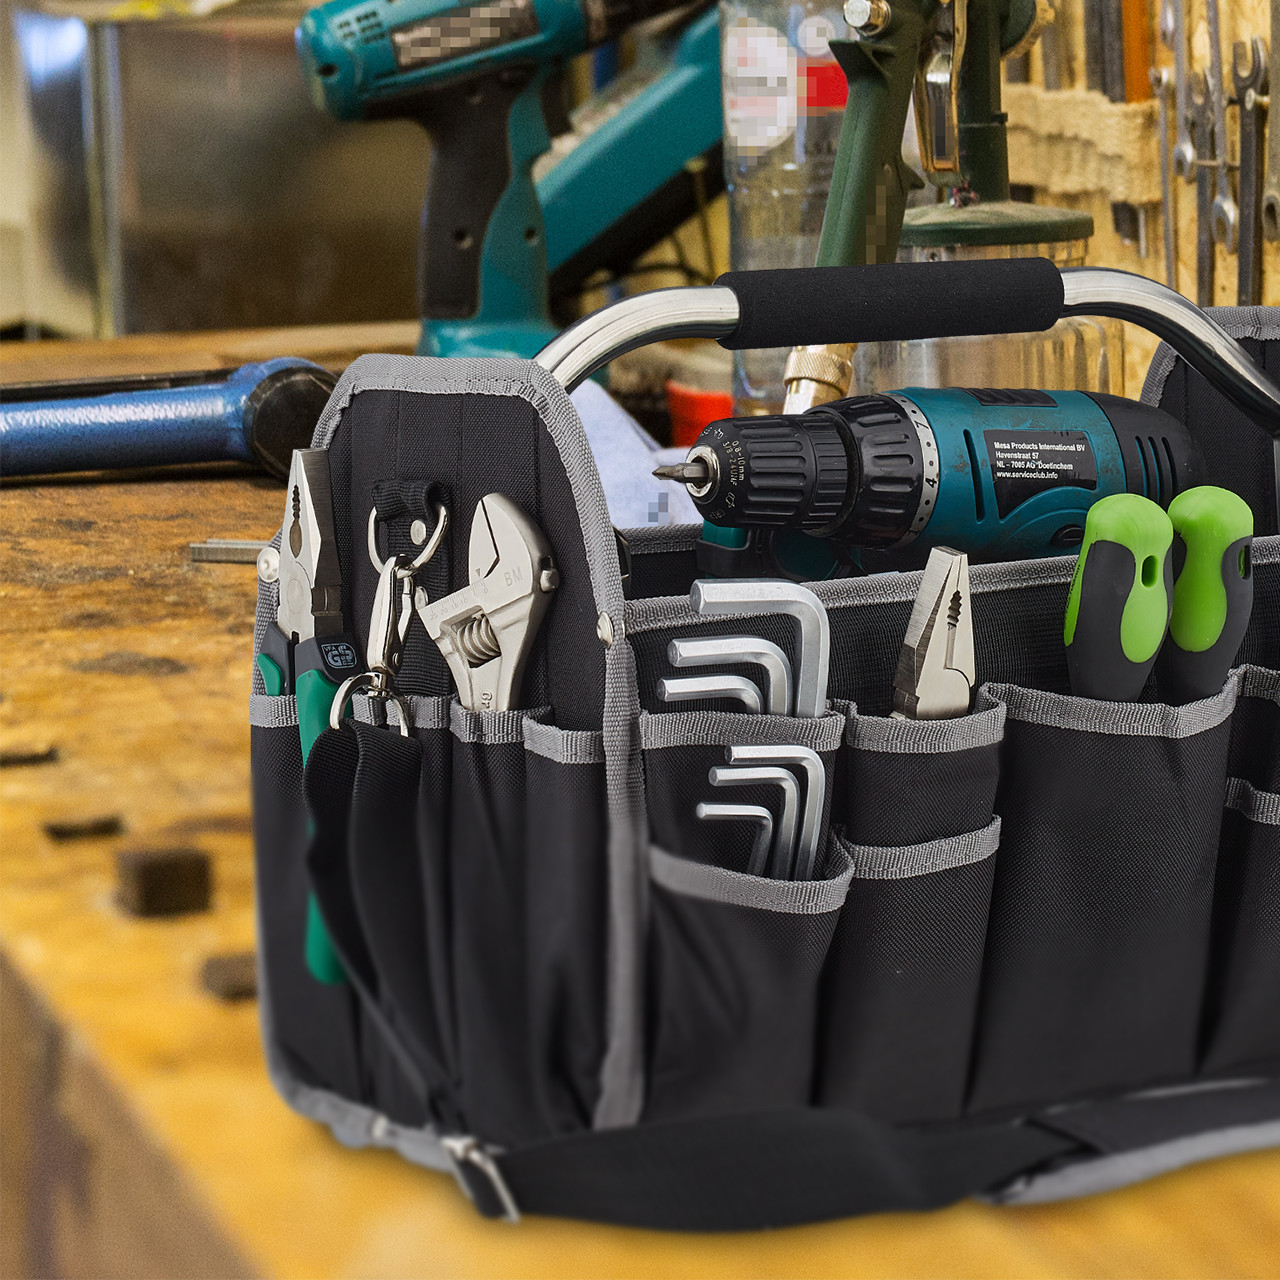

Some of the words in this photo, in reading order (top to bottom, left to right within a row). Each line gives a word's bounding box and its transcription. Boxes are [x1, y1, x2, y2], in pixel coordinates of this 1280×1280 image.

[914, 420, 929, 429] 7
[1011, 442, 1038, 450] Products
[1039, 443, 1075, 451] International
[996, 451, 1031, 459] Havenstraat
[1026, 461, 1036, 469] AG
[1038, 461, 1073, 470] Doetinchem
[997, 471, 1058, 479] www.serviceclub.info
[925, 477, 937, 488] 4
[503, 567, 523, 587] BM
